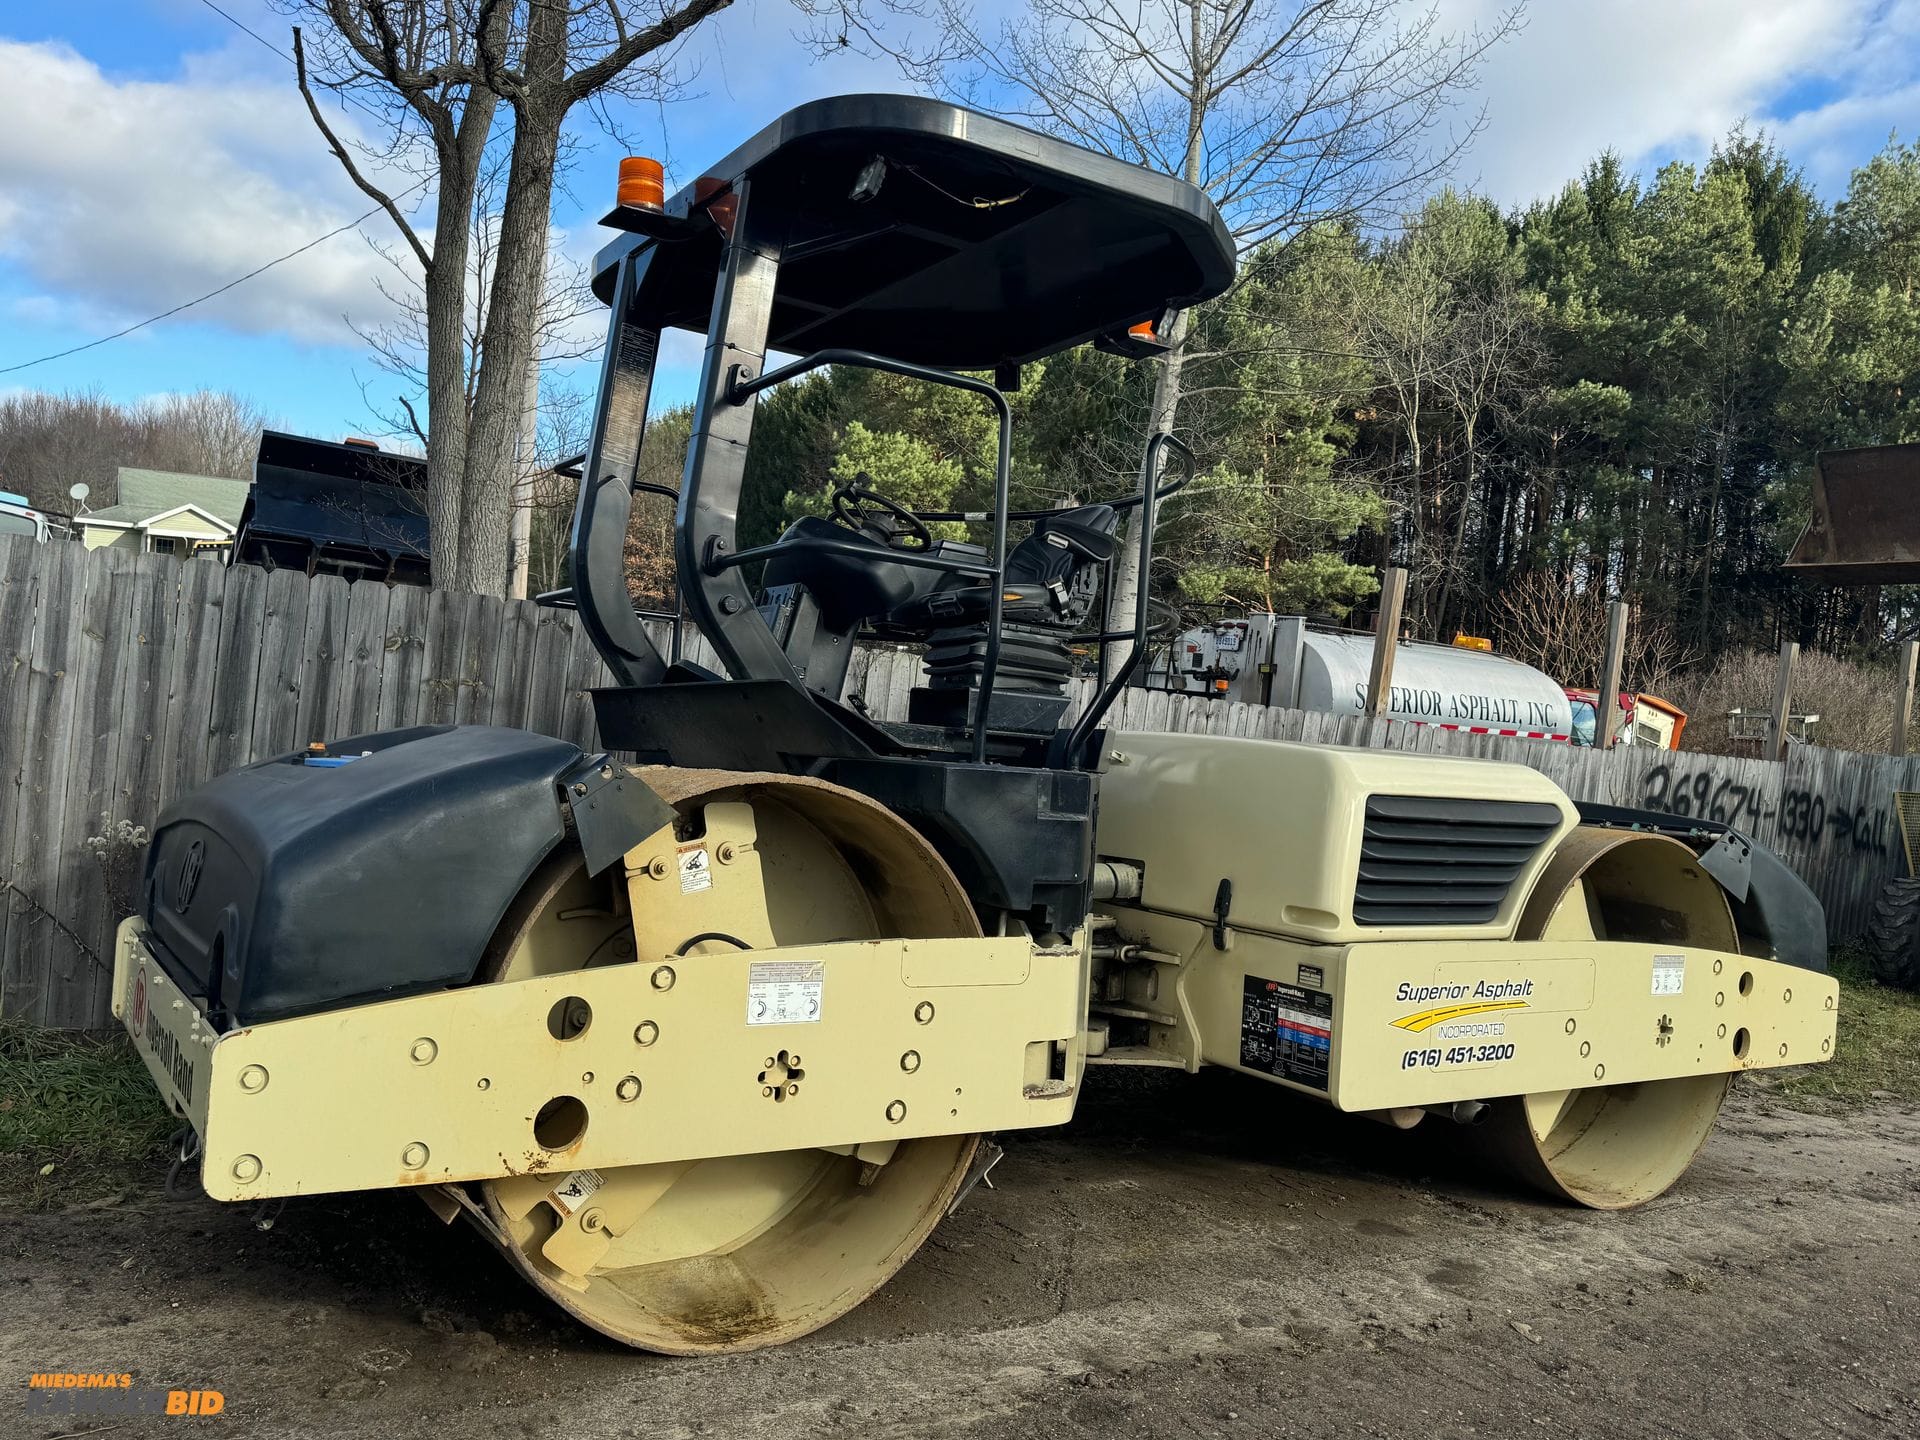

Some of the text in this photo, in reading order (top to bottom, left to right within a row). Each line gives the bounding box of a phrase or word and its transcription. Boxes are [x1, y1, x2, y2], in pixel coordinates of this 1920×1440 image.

[1354, 683, 1558, 728] SERIOR ASPHALT, INC.
[1396, 979, 1534, 1003] Superior Asphalt
[1438, 1022, 1506, 1039] INCORPORATED
[1402, 1044, 1515, 1069] (616) 451-3200
[172, 1038, 194, 1108] Rand
